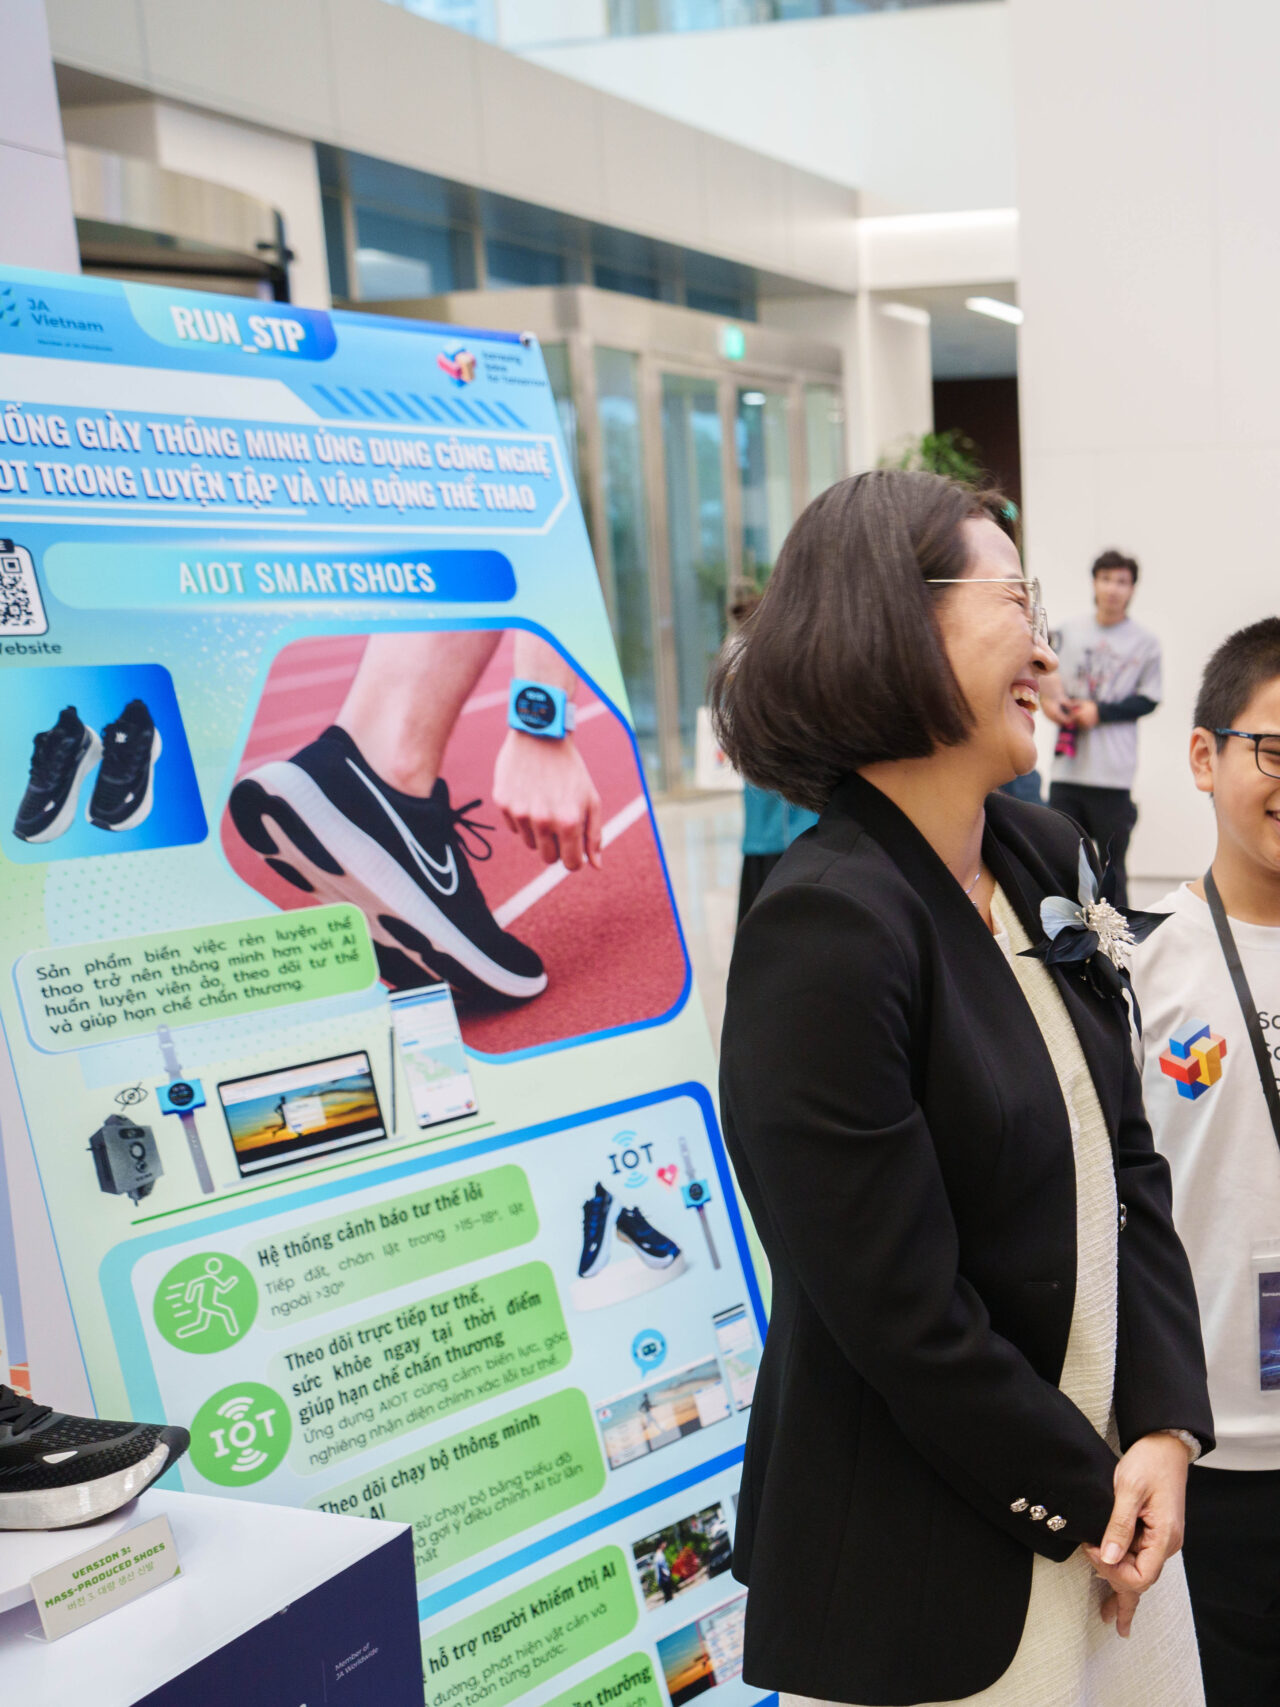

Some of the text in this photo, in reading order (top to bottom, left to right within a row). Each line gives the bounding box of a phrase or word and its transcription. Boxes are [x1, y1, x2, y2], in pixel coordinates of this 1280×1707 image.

[31, 313, 104, 332] Vietnam
[170, 305, 305, 353] RUN_STP
[76, 411, 141, 452] GIÀY
[148, 416, 241, 457] THÔNG
[245, 429, 312, 463] MINH
[314, 427, 366, 465] ỨNG
[368, 437, 433, 472] DỤNG
[434, 437, 494, 472] CÔNG
[496, 443, 551, 479] NGHỆ
[34, 461, 137, 497] TRONG
[142, 463, 227, 507] LUYỆN
[228, 466, 277, 509] TẬP
[282, 467, 319, 505] VÀ
[320, 470, 370, 511] VẬN
[371, 473, 436, 513] ĐỘNG
[479, 483, 536, 512] THAO
[179, 561, 436, 595] AIOT SMARTSHOES
[0, 641, 62, 655] ebsite
[36, 963, 70, 981] Sản
[85, 953, 132, 976] phẩm
[144, 946, 181, 963] biến
[193, 939, 227, 954] việc
[239, 933, 265, 947] rèn
[276, 925, 317, 941] luyện
[41, 934, 356, 998] thao trở nên thông minh hơn với AI
[44, 998, 90, 1017] huấn
[100, 989, 147, 1008] luyện
[156, 981, 191, 996] viên
[233, 968, 270, 983] theo
[309, 957, 327, 969] tư
[50, 1019, 73, 1034] và
[80, 1013, 117, 1031] giúp
[123, 1006, 156, 1022] hạn
[162, 996, 192, 1014] chế
[198, 989, 237, 1008] chấn
[608, 1142, 653, 1175] IOT
[257, 1245, 280, 1268] Hệ
[284, 1233, 334, 1259] thống
[337, 1222, 376, 1242] cảnh
[379, 1208, 408, 1229] báo
[412, 1202, 431, 1218] tư
[435, 1188, 461, 1211] thế
[265, 1277, 295, 1295] Tiếp
[408, 1228, 446, 1248] trong
[270, 1291, 313, 1317] ngoài
[284, 1348, 324, 1372] Theo
[328, 1332, 354, 1355] dõi
[357, 1322, 393, 1344] trực
[396, 1306, 427, 1331] tiếp
[430, 1300, 448, 1318] tư
[292, 1374, 322, 1397] sức
[332, 1355, 372, 1381] khỏe
[383, 1337, 421, 1362] ngay
[431, 1322, 453, 1344] tại
[464, 1306, 496, 1331] thời
[299, 1331, 505, 1425] giúp hạn chế chấn thương
[379, 1391, 410, 1413] AIOT
[209, 1408, 276, 1458] IOT
[309, 1433, 367, 1466] nghiêng
[362, 1477, 387, 1502] dõi
[391, 1463, 425, 1489] chạy
[430, 1449, 449, 1472] bộ
[453, 1432, 499, 1461] thông
[502, 1413, 541, 1440] minh
[371, 1503, 386, 1520] AI
[434, 1501, 467, 1523] chạy
[44, 1542, 166, 1608] MASS-PRODUCED SHOES
[72, 1546, 132, 1580] VERSION 3:
[137, 1561, 155, 1576] 신발
[428, 1562, 616, 1674] hỗ trợ người khiếm thị AI
[335, 1642, 370, 1671] Member of
[336, 1647, 379, 1680] JA Worldwide
